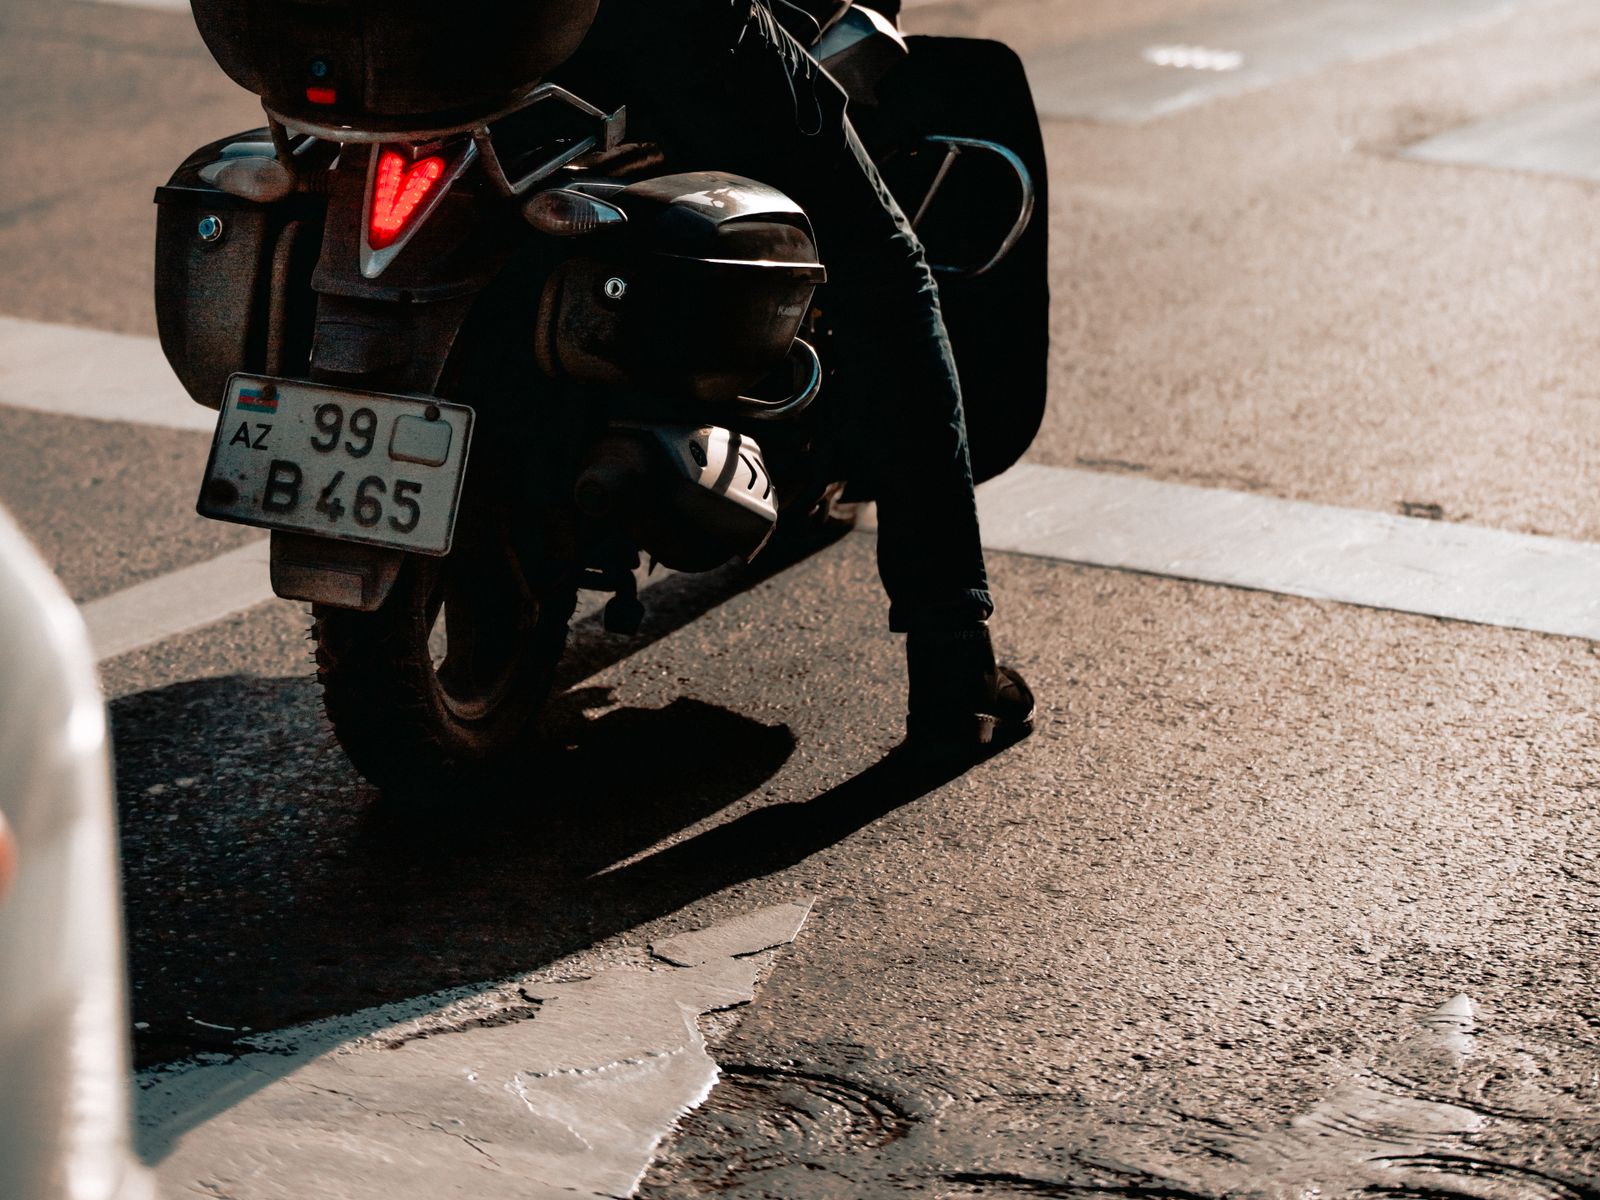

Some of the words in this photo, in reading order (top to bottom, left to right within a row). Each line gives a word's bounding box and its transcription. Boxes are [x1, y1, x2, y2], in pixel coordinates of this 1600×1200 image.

[229, 421, 272, 450] AZ
[310, 403, 378, 458] 99
[262, 459, 303, 513] B
[315, 470, 423, 534] 465
